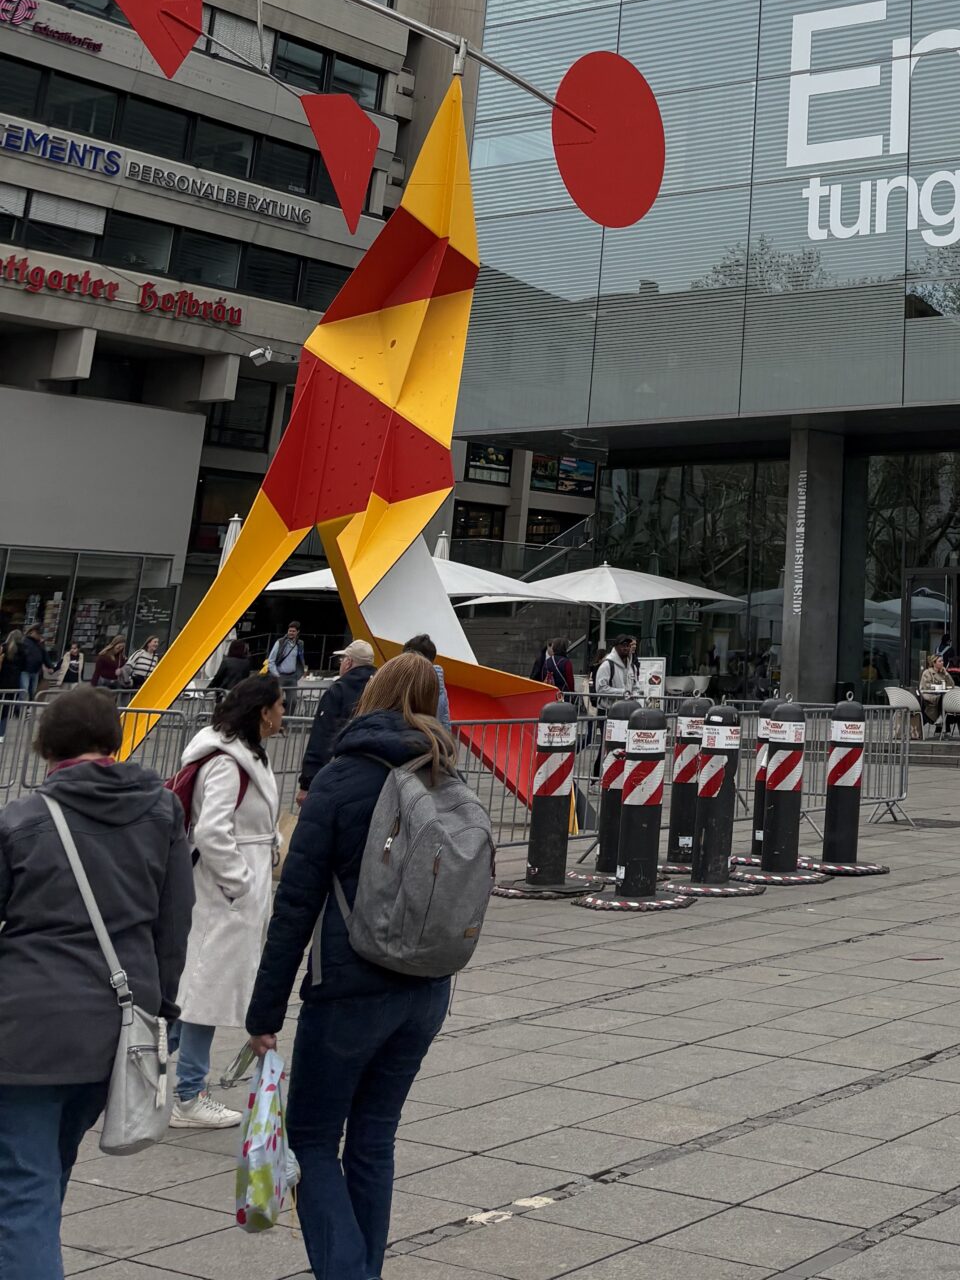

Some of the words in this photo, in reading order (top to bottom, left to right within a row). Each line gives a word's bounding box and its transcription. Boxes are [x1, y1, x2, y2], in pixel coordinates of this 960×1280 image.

[0, 123, 122, 176] EMENTS
[126, 161, 312, 225] PERSONALBERATUNG
[0, 254, 119, 301] ttgarter
[139, 280, 243, 327] Hofbräu
